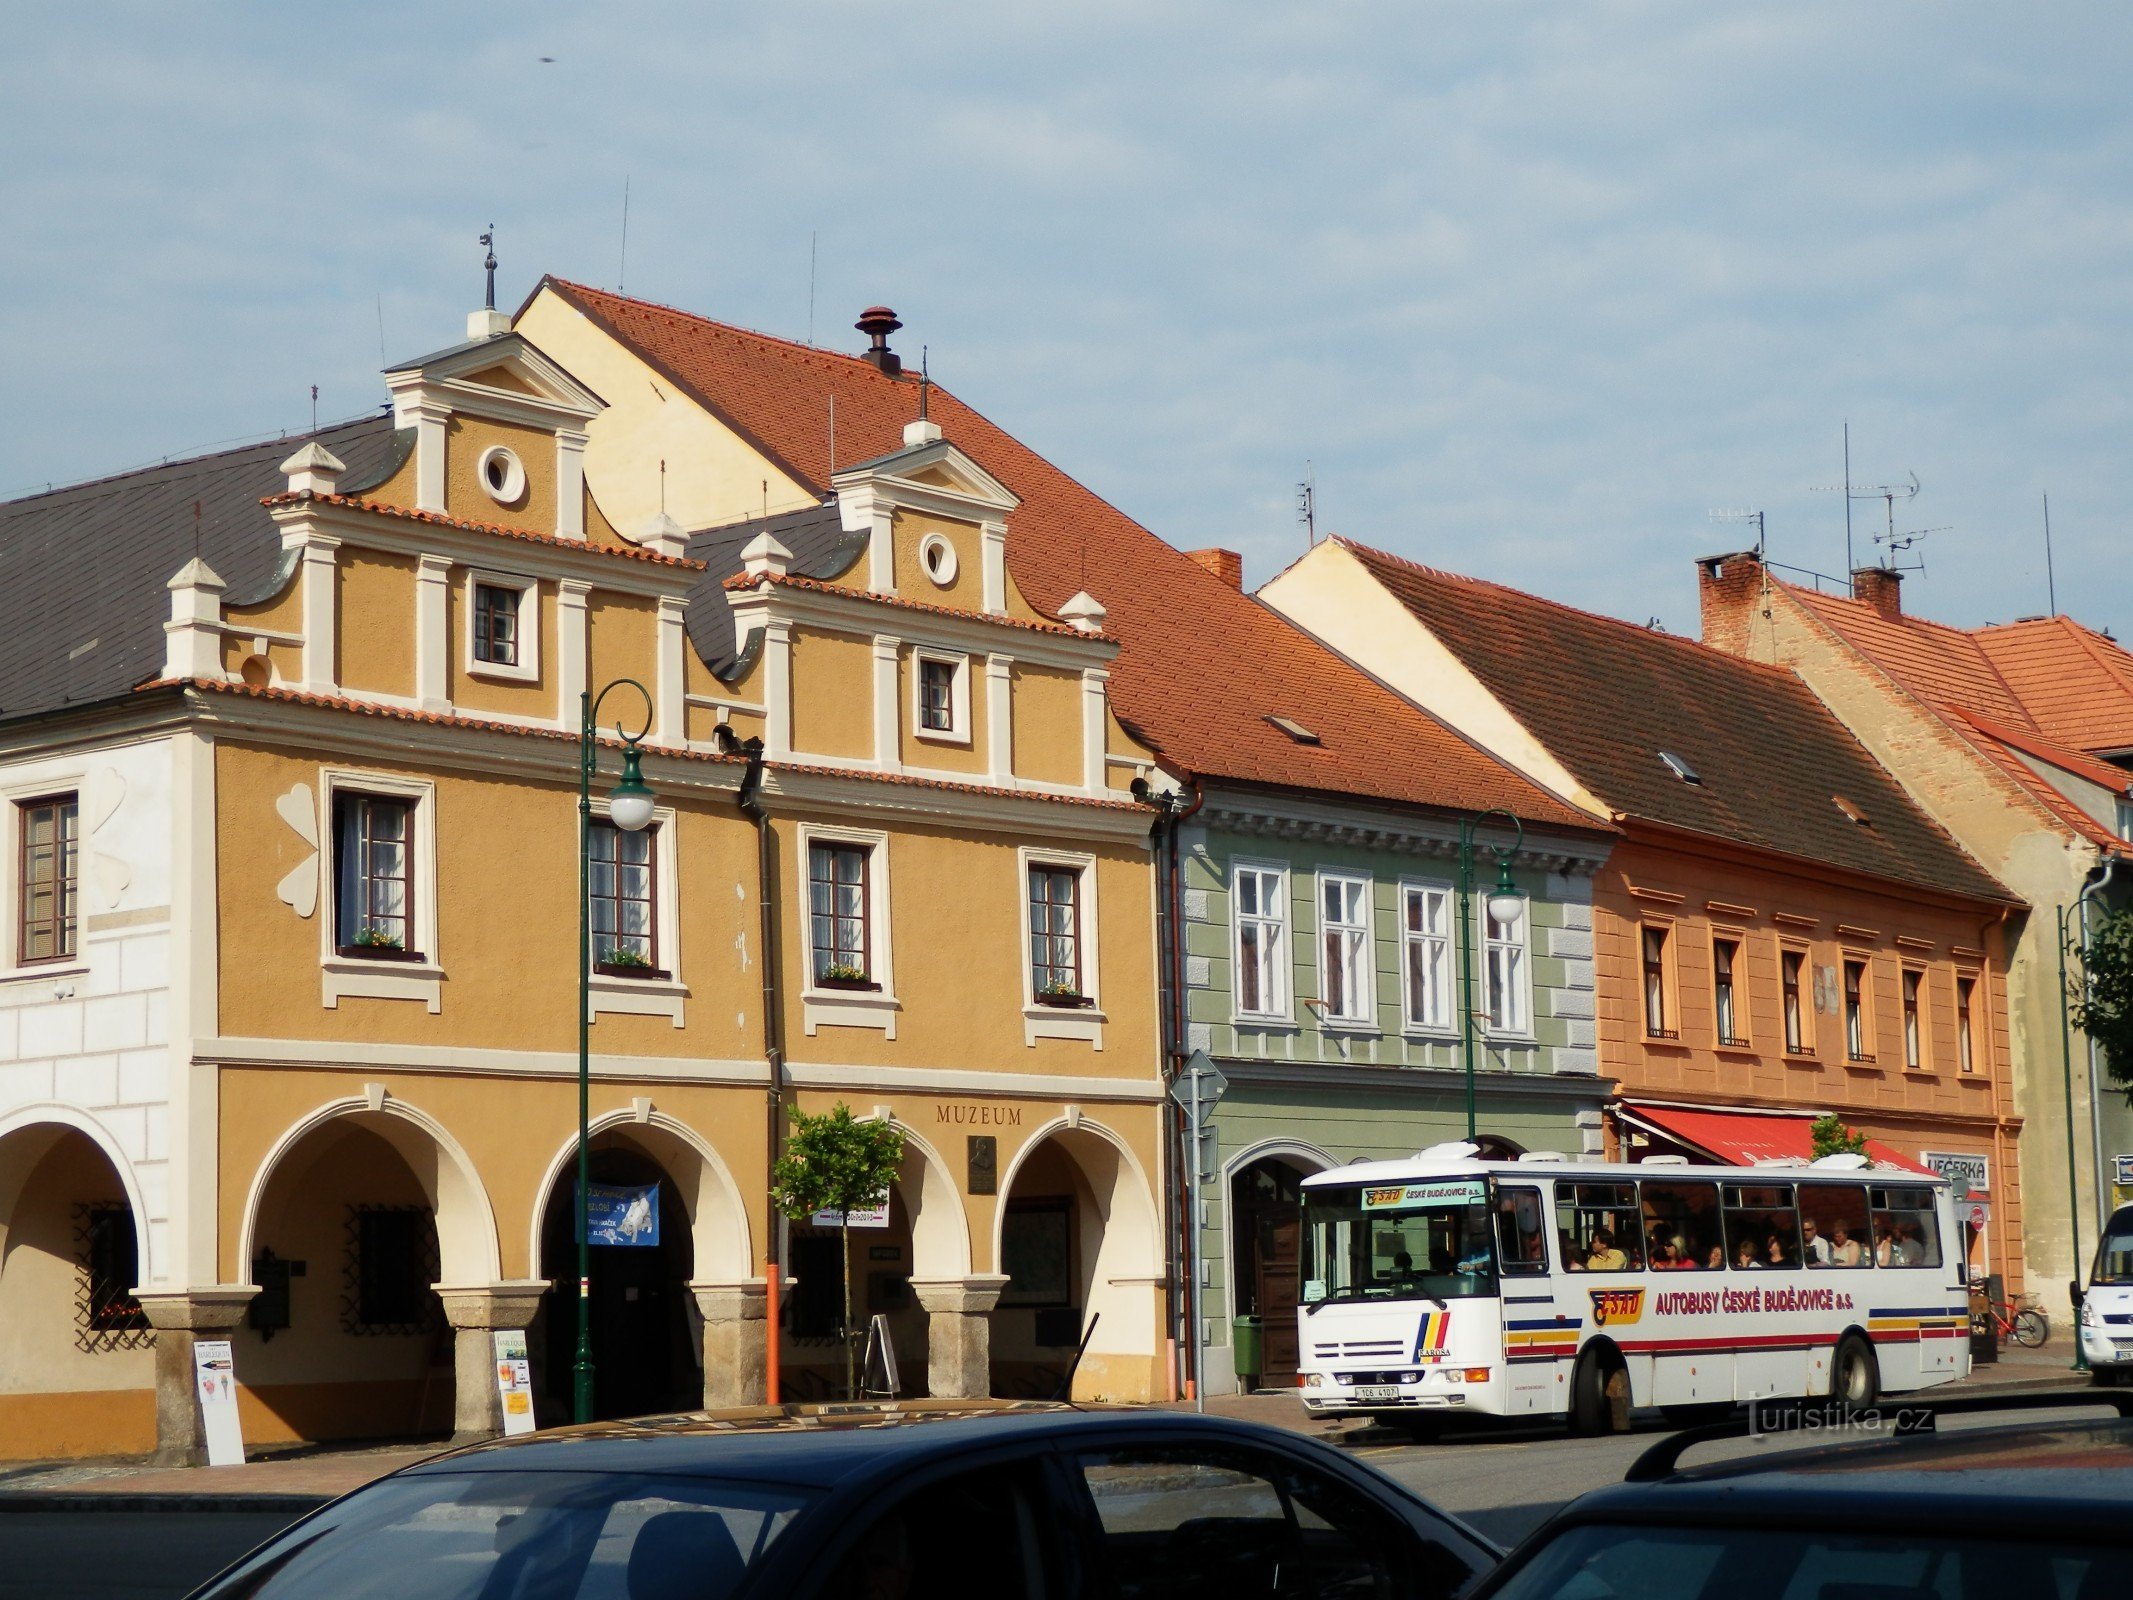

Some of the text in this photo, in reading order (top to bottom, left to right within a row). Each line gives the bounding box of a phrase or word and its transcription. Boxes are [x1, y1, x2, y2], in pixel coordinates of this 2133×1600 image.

[936, 1105, 1021, 1125] MUZEUM
[1406, 1189, 1426, 1199] ČESKÉ
[1427, 1187, 1467, 1198] BUDĚJOVICE
[1655, 1285, 1854, 1315] AUTOBUSY ČESKÉ BUDĚJOVICE a.s.
[1419, 1348, 1450, 1357] KAROSA
